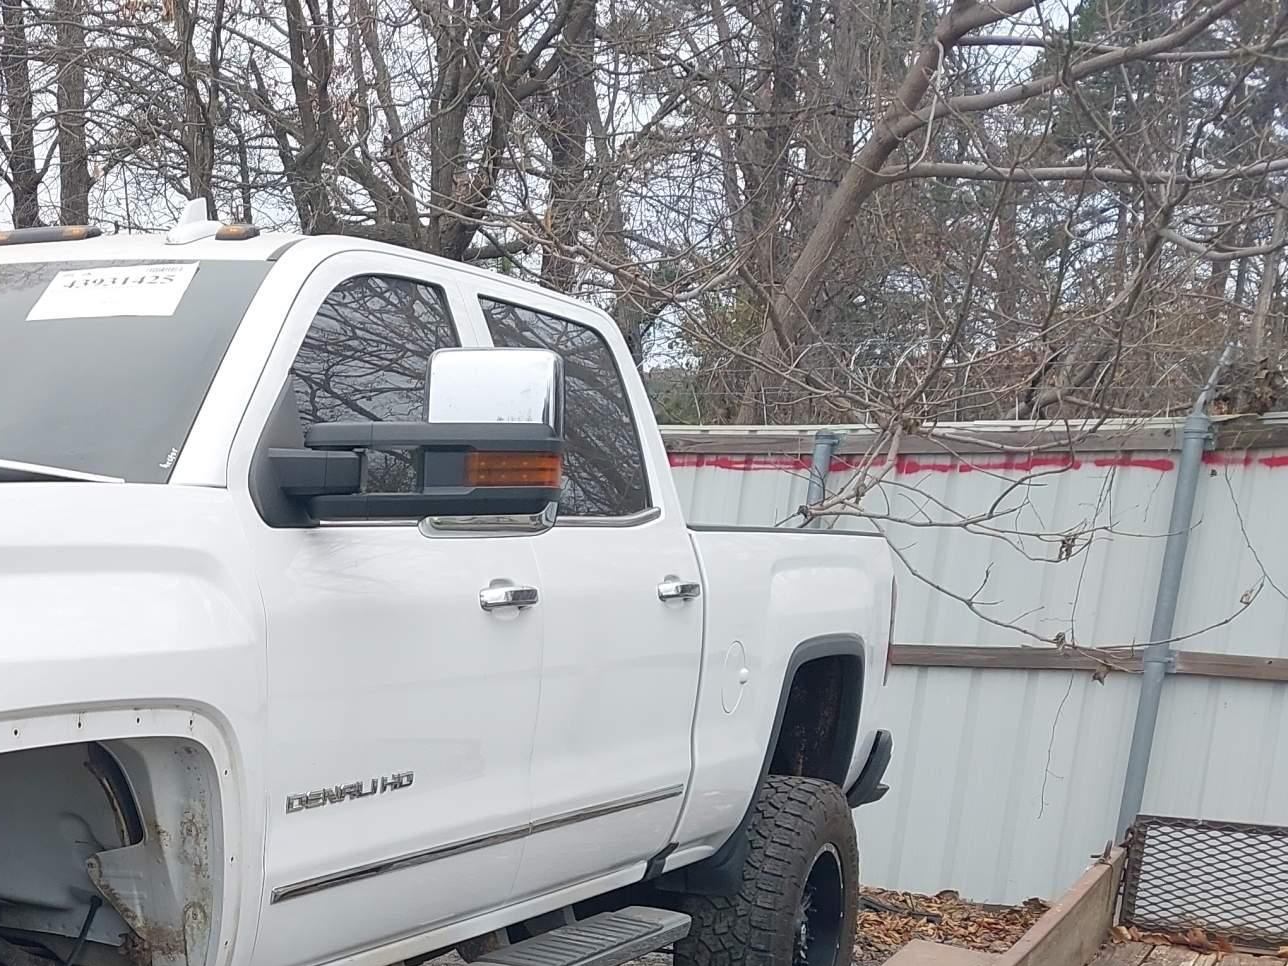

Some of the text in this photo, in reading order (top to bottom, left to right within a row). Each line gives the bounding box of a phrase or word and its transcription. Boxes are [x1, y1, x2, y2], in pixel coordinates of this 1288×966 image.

[63, 274, 176, 289] 43931425
[285, 770, 414, 814] DENALI HD
